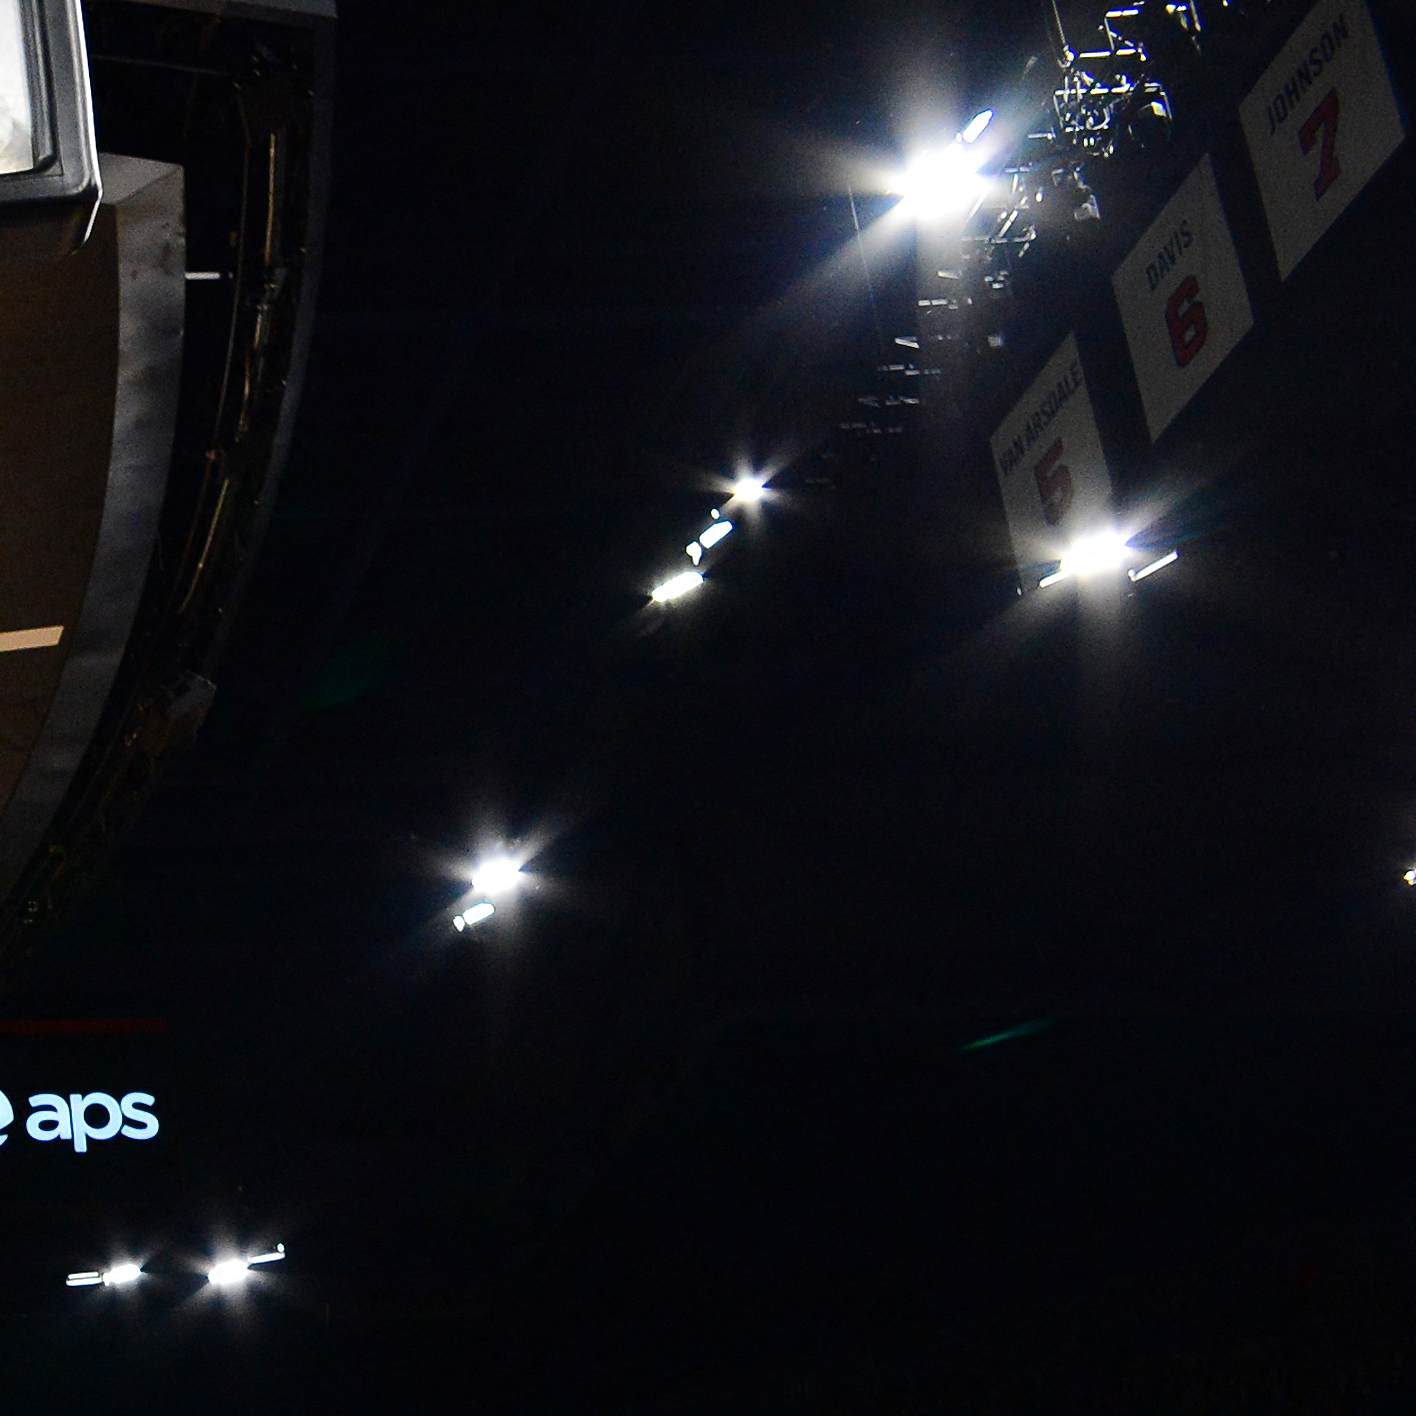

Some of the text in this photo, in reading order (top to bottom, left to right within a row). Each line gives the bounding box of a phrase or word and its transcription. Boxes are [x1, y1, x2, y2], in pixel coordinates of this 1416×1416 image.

[1269, 14, 1350, 134] JOHNSON
[1298, 91, 1340, 201] 7
[1145, 219, 1193, 292] DAVIS
[1166, 275, 1208, 368] 6
[26, 1091, 160, 1154] aps
